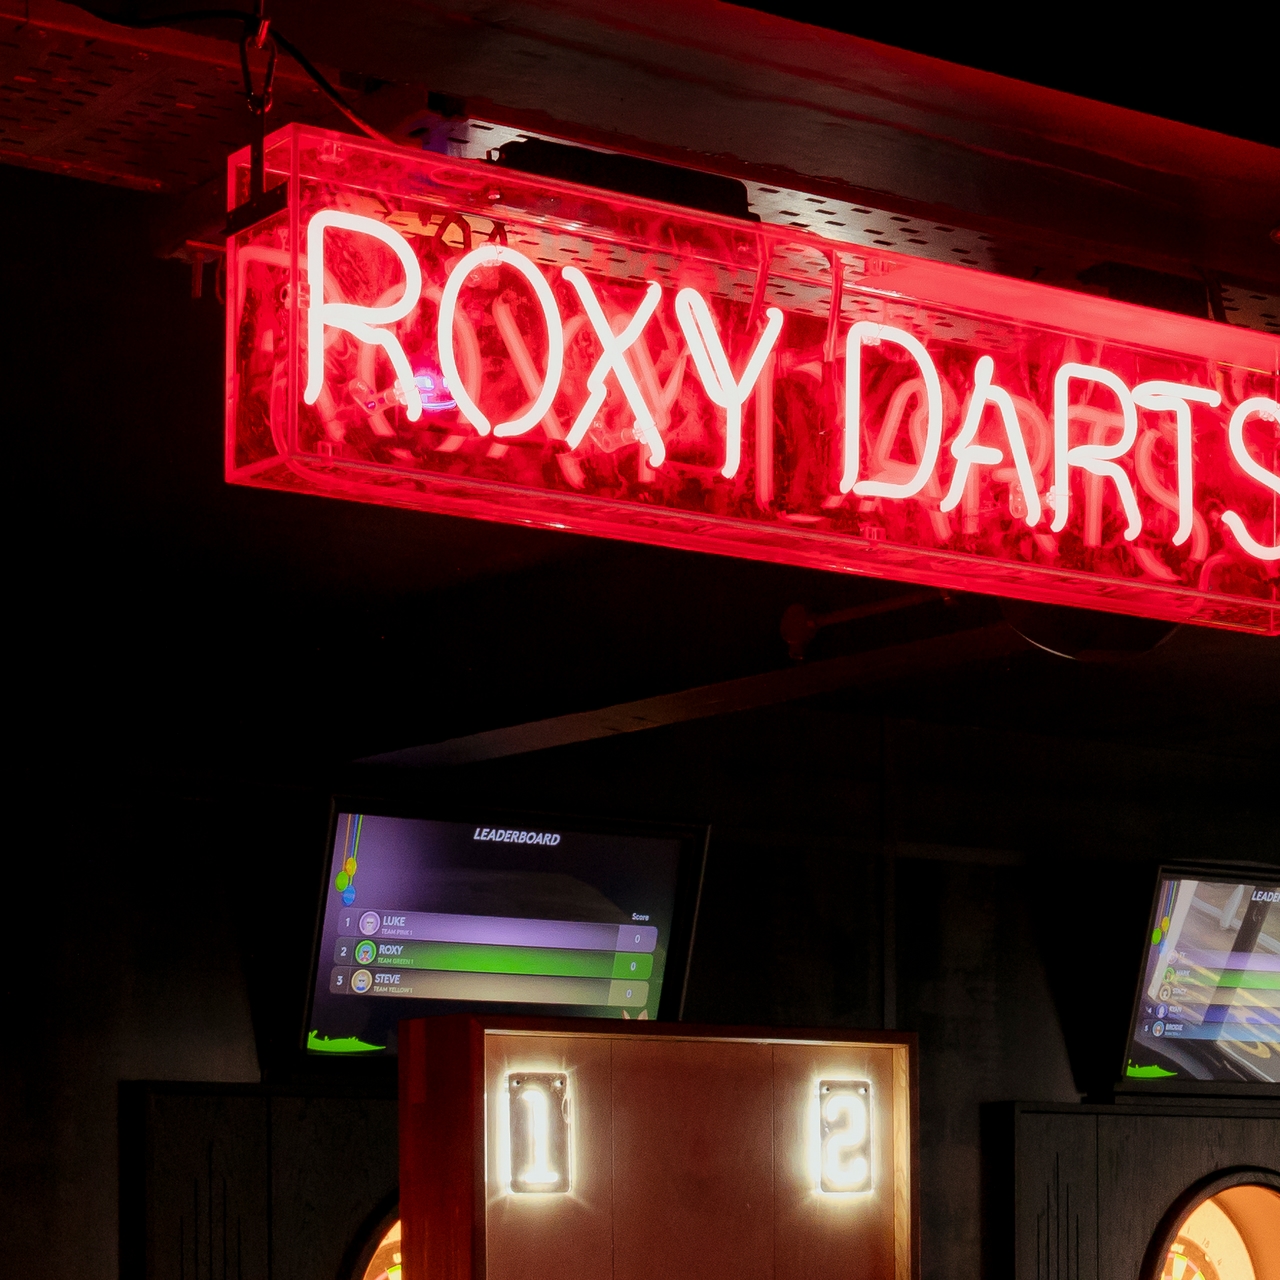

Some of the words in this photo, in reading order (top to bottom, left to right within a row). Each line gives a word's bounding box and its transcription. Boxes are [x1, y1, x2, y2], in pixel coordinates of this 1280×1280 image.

[302, 208, 783, 479] ROXY
[473, 827, 561, 846] LEADERBOARD
[345, 917, 351, 927] 1
[382, 915, 406, 927] LUKE
[631, 912, 650, 921] Score
[634, 934, 641, 943] 0
[340, 946, 347, 957] 2
[378, 944, 404, 955] ROXY
[630, 962, 636, 971] 0
[336, 975, 343, 986] 3
[374, 973, 401, 984] STEVE
[626, 989, 632, 998] 0
[521, 1089, 559, 1184] 1
[825, 1096, 868, 1184] 2
[1202, 1238, 1210, 1249] 18
